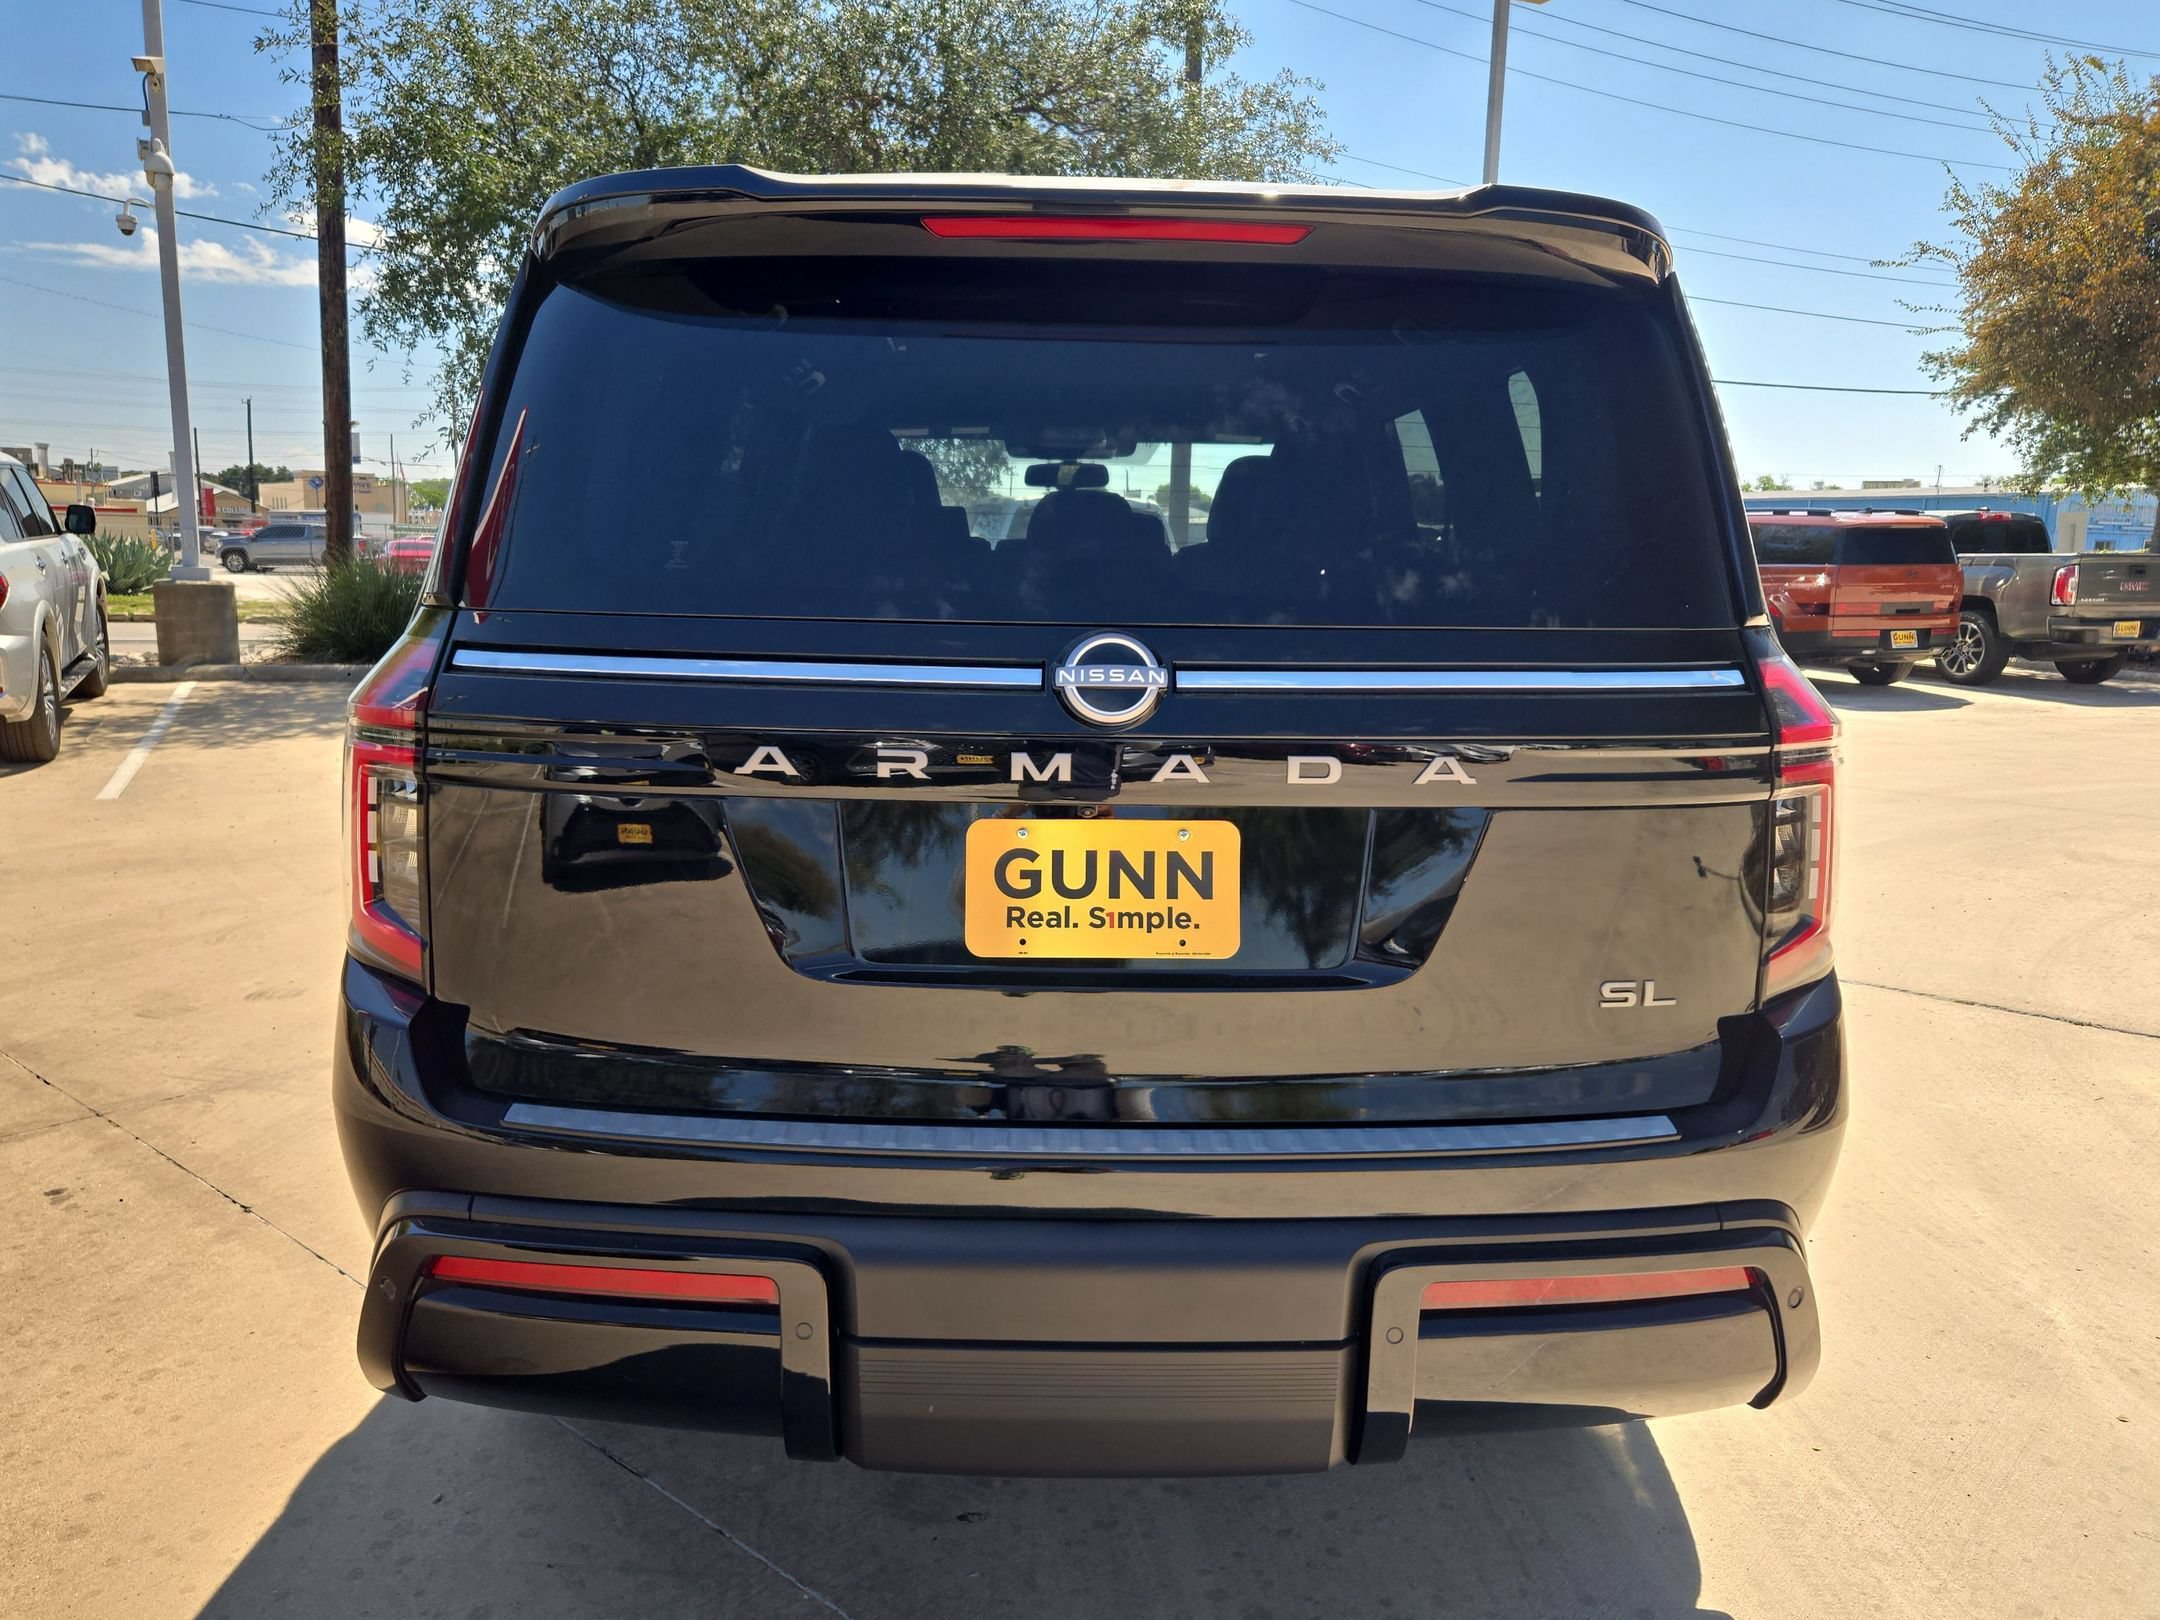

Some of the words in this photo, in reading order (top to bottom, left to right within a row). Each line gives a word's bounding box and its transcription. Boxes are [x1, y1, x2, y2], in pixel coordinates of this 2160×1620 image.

[1893, 632, 1914, 641] GUNN
[1058, 668, 1165, 685] NISSAN
[734, 745, 1478, 786] ARMADA
[994, 847, 1214, 900] GUNN
[1006, 905, 1079, 929] Real.
[1599, 979, 1677, 1007] SL
